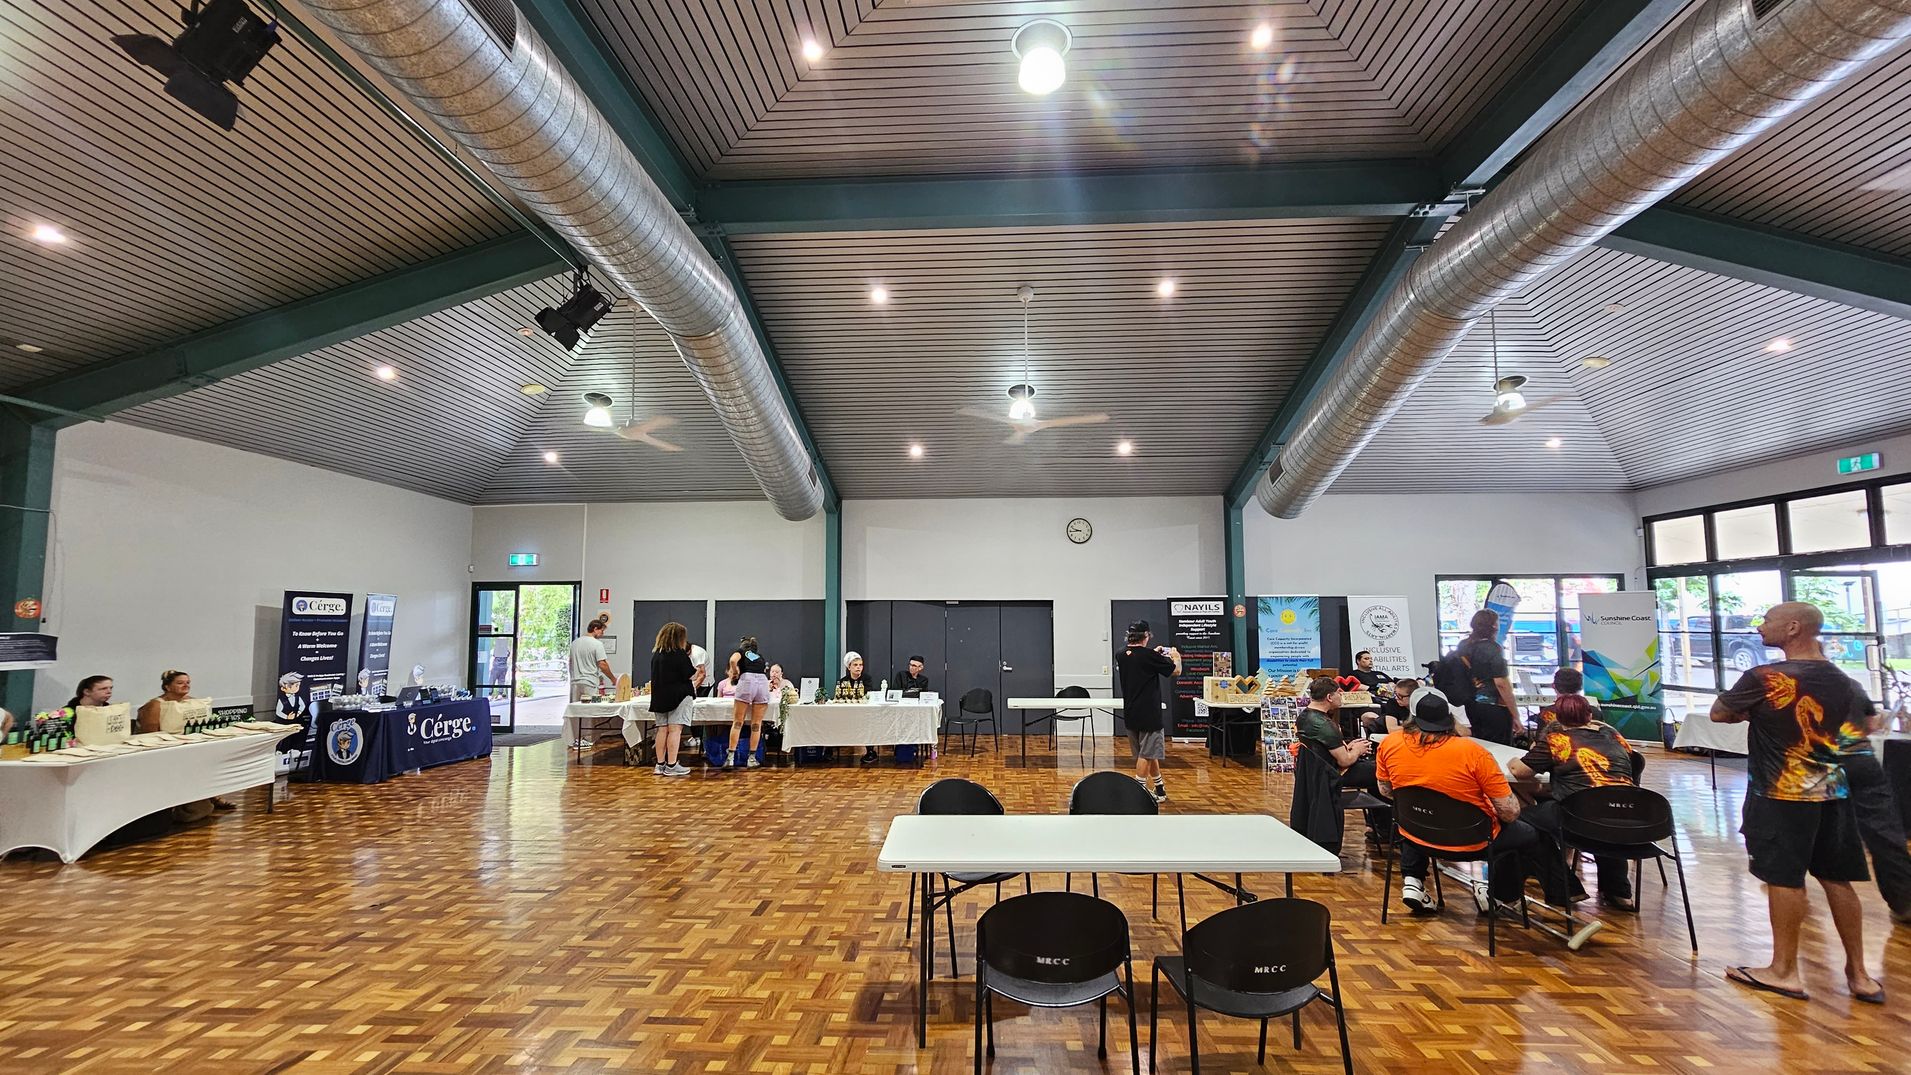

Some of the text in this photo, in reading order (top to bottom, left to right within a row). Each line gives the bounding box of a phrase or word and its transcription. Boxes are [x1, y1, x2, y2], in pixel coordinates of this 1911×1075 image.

[309, 599, 344, 613] Cérge.
[1036, 956, 1070, 965] MRCC
[1254, 964, 1287, 974] MRCC
